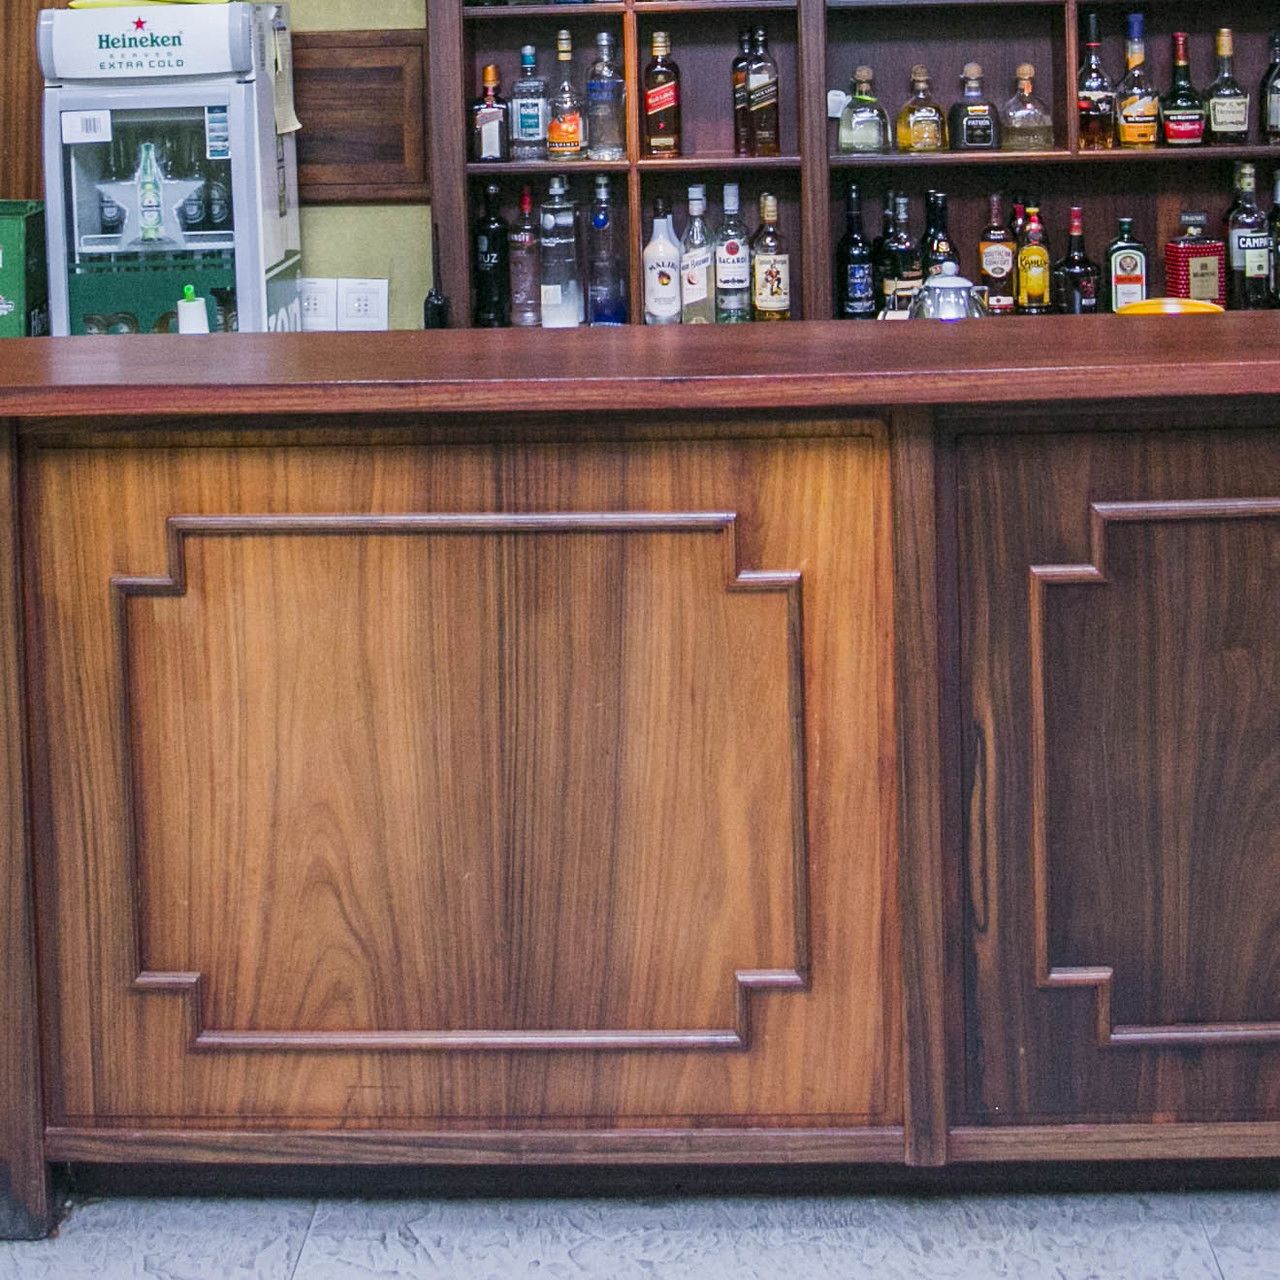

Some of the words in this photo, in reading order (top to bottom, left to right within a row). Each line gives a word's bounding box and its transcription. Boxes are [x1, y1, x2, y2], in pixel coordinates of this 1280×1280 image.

[98, 32, 182, 49] Heineken
[99, 61, 144, 70] EXTRA
[148, 59, 184, 69] COLD
